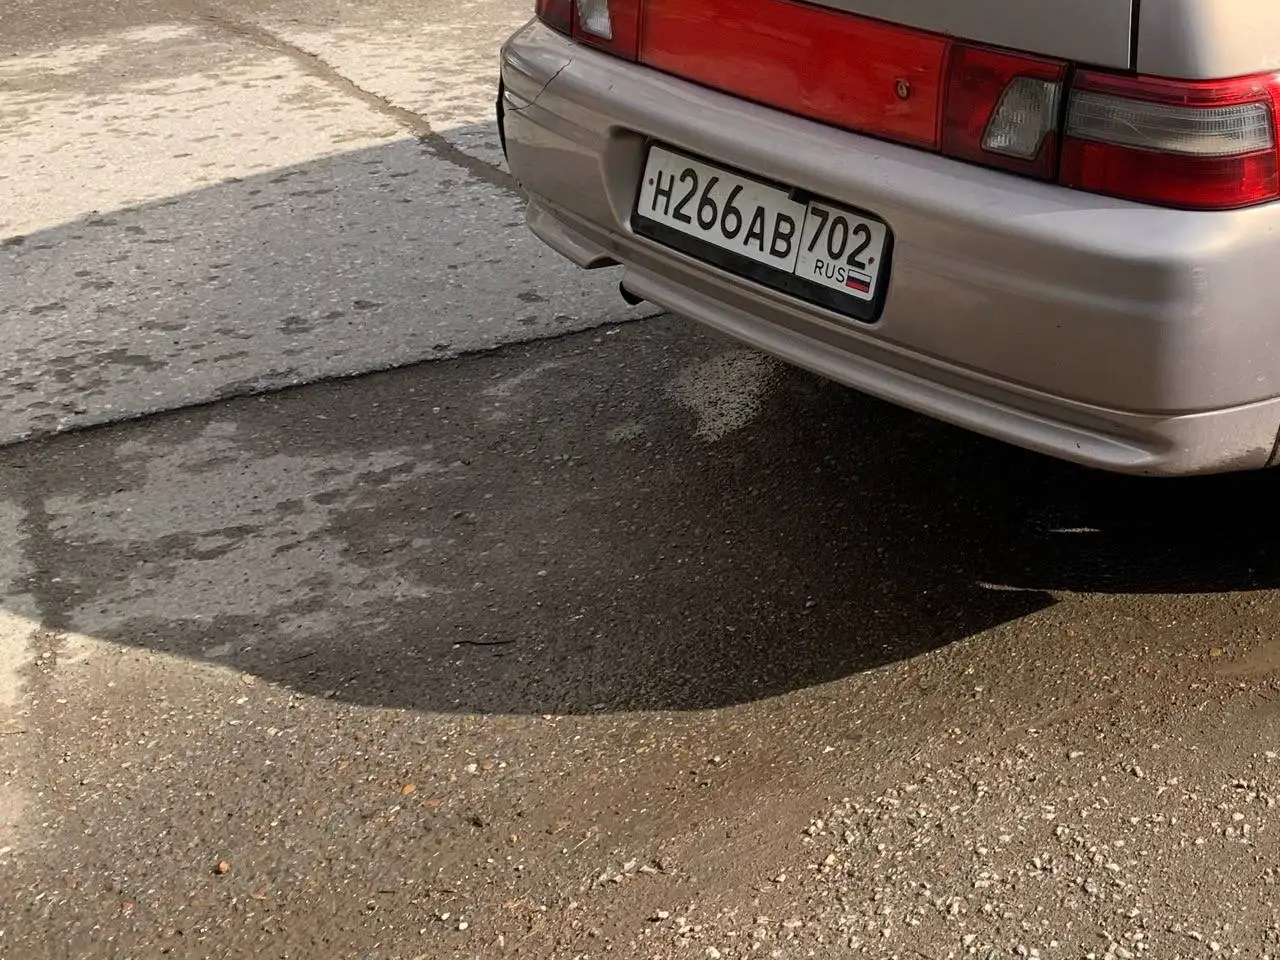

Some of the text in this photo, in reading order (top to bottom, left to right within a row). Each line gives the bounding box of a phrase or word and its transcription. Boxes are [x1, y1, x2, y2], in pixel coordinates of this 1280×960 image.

[651, 167, 872, 271] Н266АВ 702
[813, 258, 846, 283] RUS
